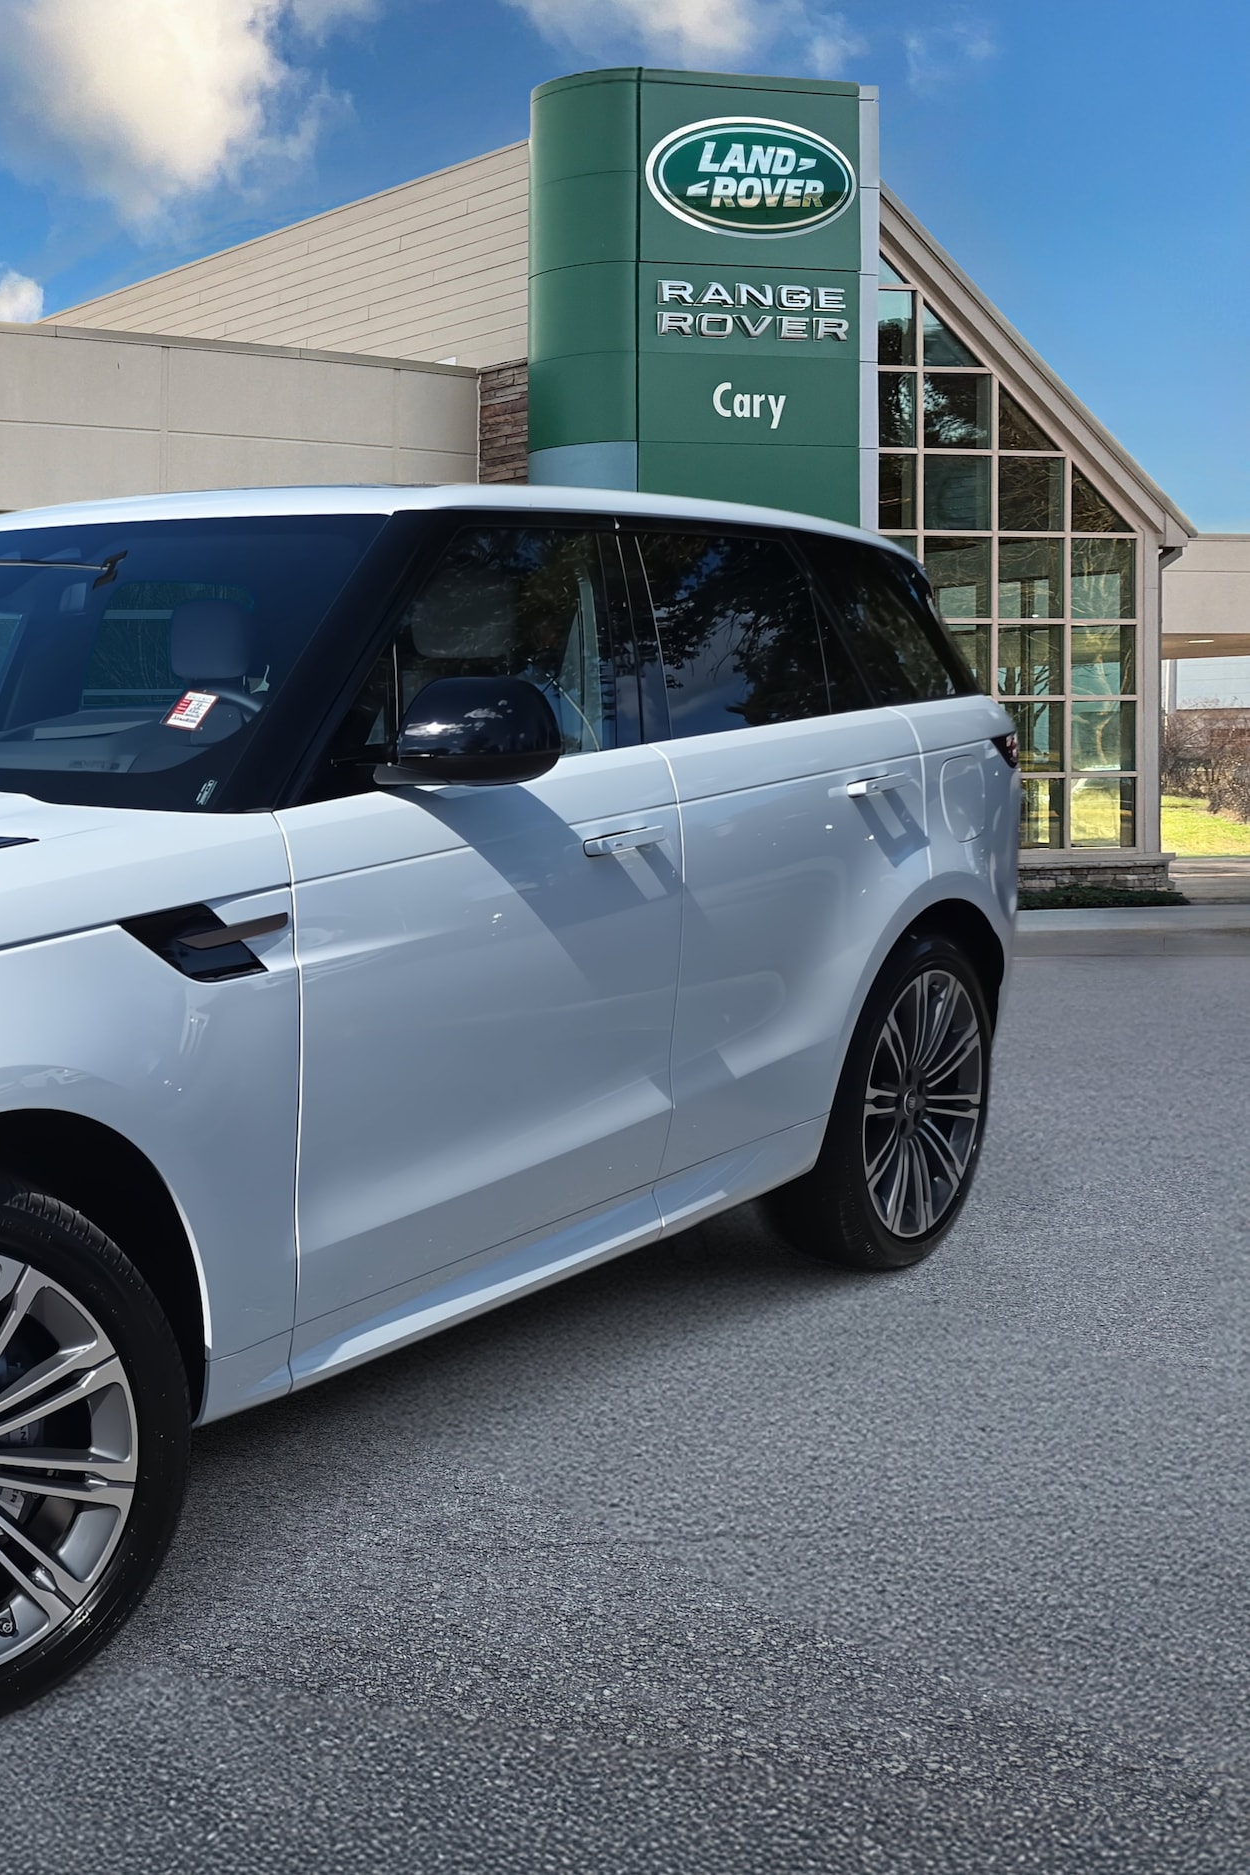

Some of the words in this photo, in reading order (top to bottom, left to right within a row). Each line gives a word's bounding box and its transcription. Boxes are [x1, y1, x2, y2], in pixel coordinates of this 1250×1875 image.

[698, 141, 796, 175] LAND
[710, 176, 825, 208] ROVER
[657, 280, 847, 312] RANGE
[657, 311, 850, 342] ROVER
[712, 382, 787, 429] Cary
